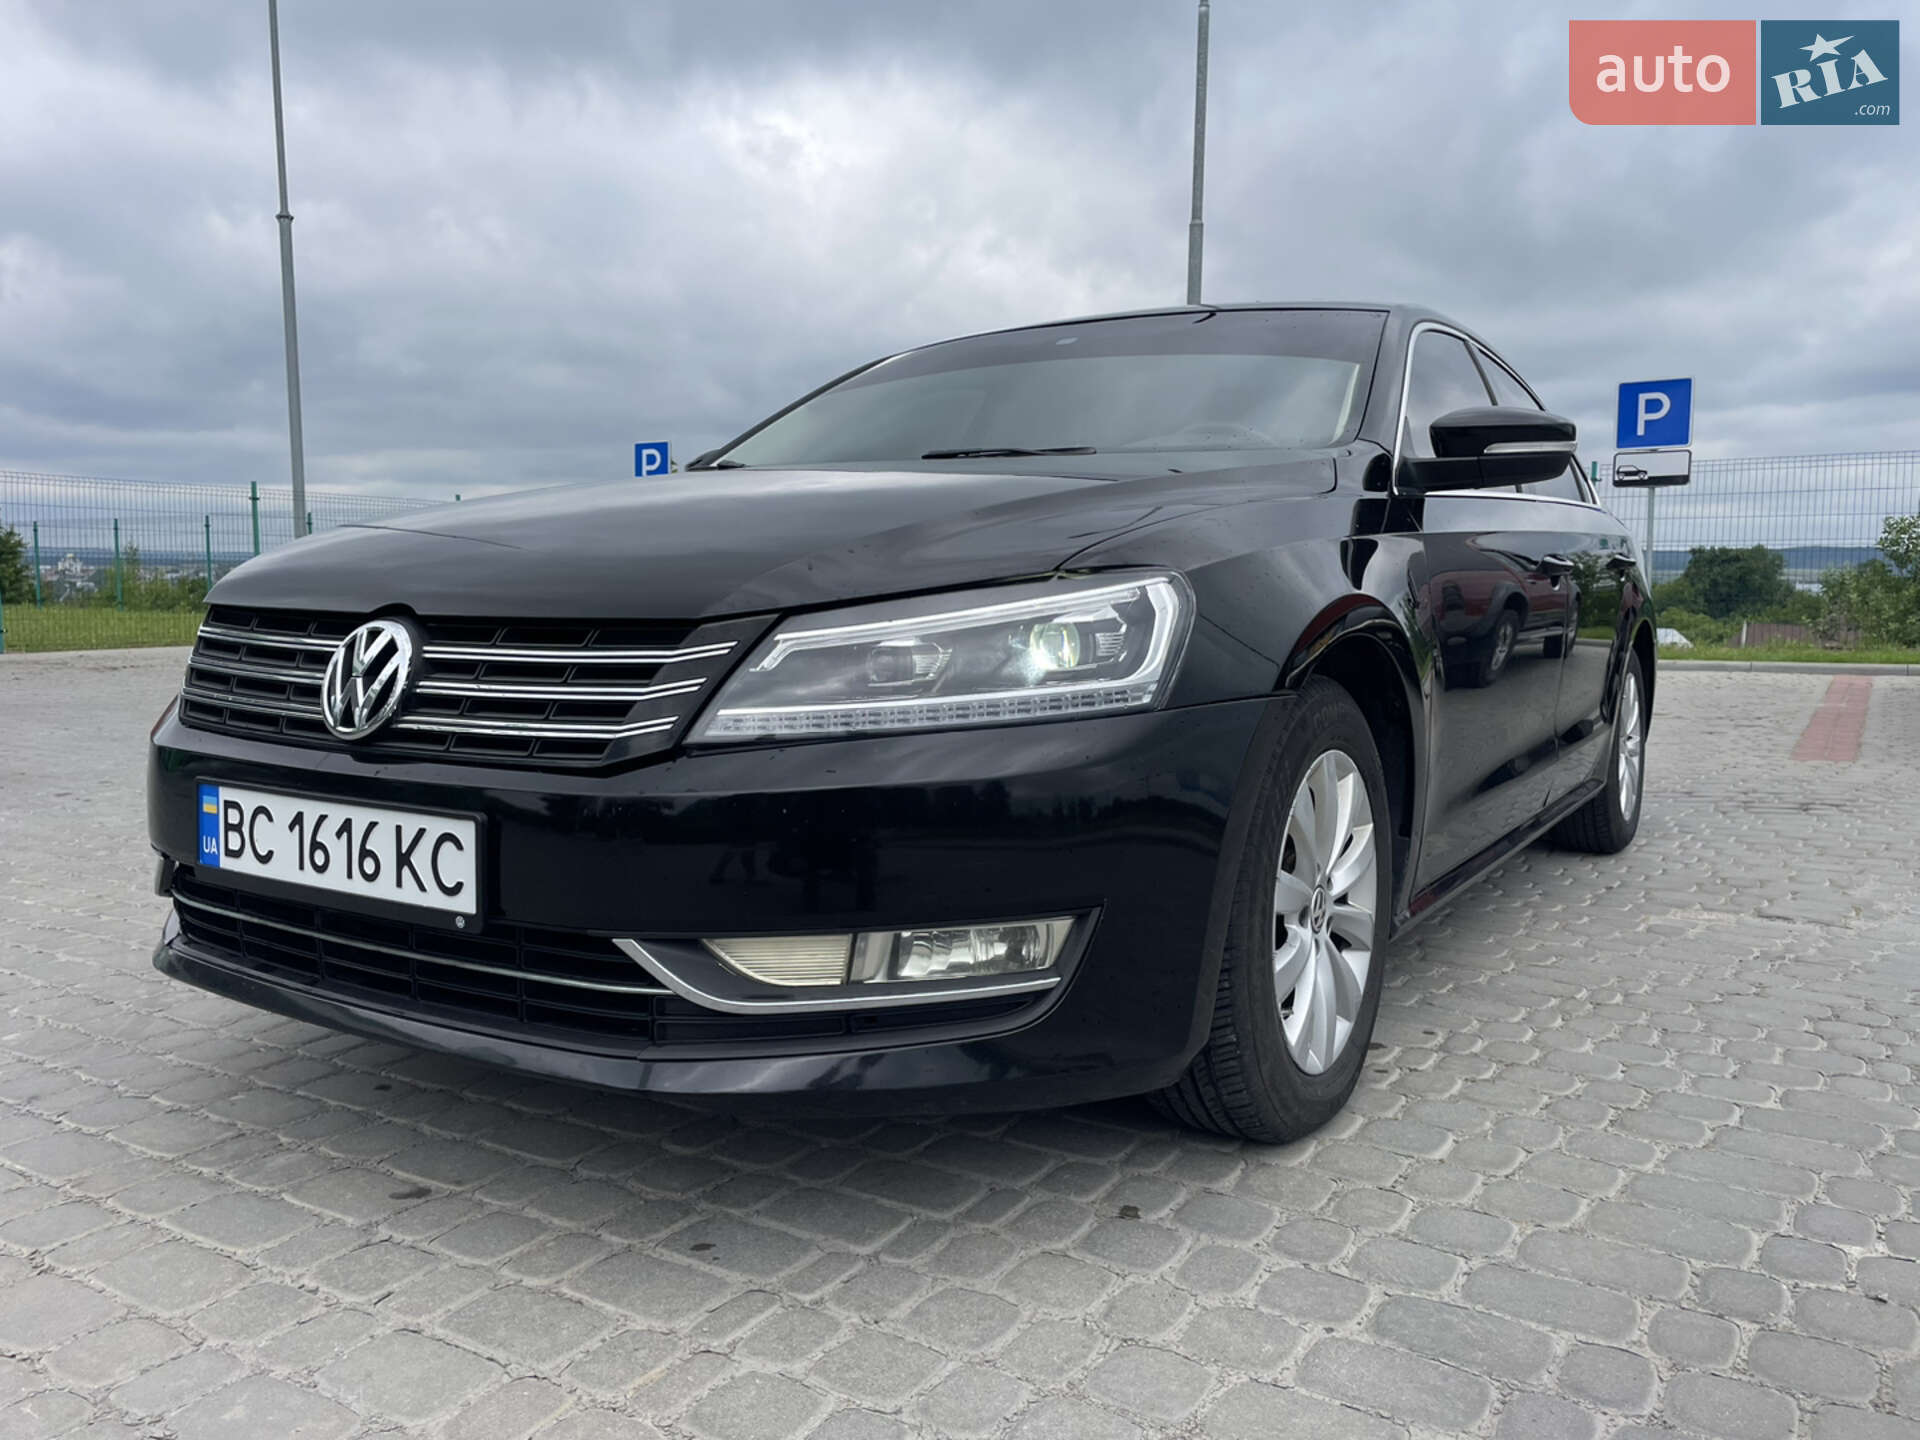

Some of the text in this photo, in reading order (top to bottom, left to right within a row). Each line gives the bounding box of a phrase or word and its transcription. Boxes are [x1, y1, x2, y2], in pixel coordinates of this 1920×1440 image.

[1636, 391, 1671, 436] P
[642, 448, 661, 478] P
[202, 835, 218, 855] UA
[223, 799, 464, 897] BC 1616 KC
